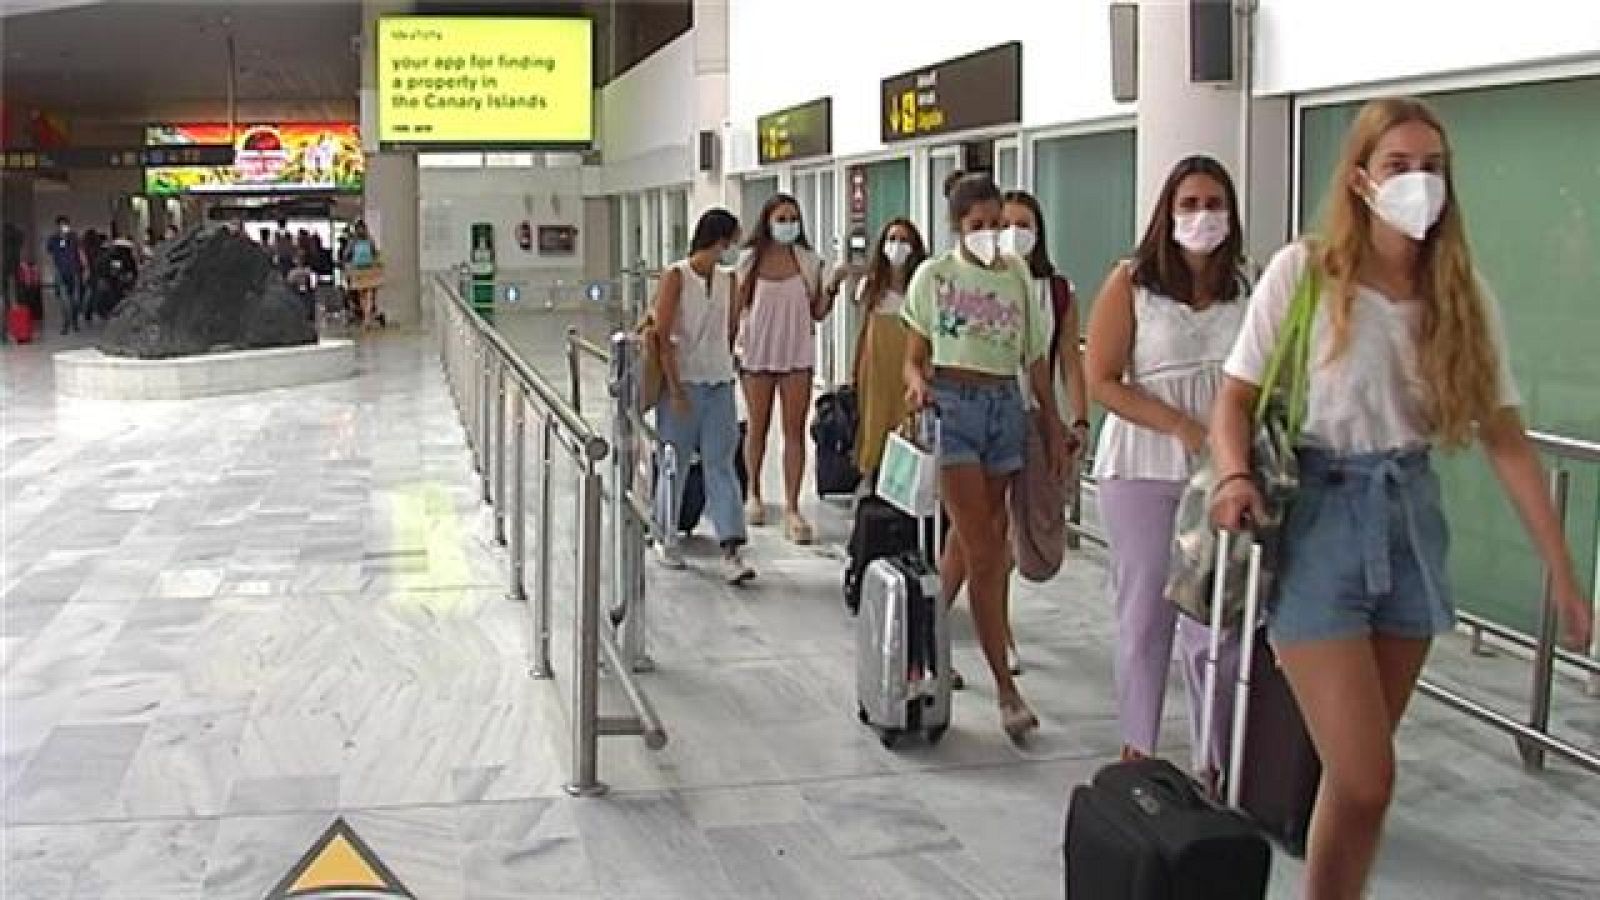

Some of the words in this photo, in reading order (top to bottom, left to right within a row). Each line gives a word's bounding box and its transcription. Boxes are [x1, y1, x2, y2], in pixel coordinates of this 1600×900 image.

[392, 57, 429, 71] your
[435, 57, 465, 70] app
[470, 53, 493, 69] for
[497, 54, 556, 72] finding
[392, 77, 402, 88] a
[407, 75, 478, 91] property
[482, 75, 498, 88] in
[392, 95, 420, 108] the
[424, 93, 482, 110] Canary
